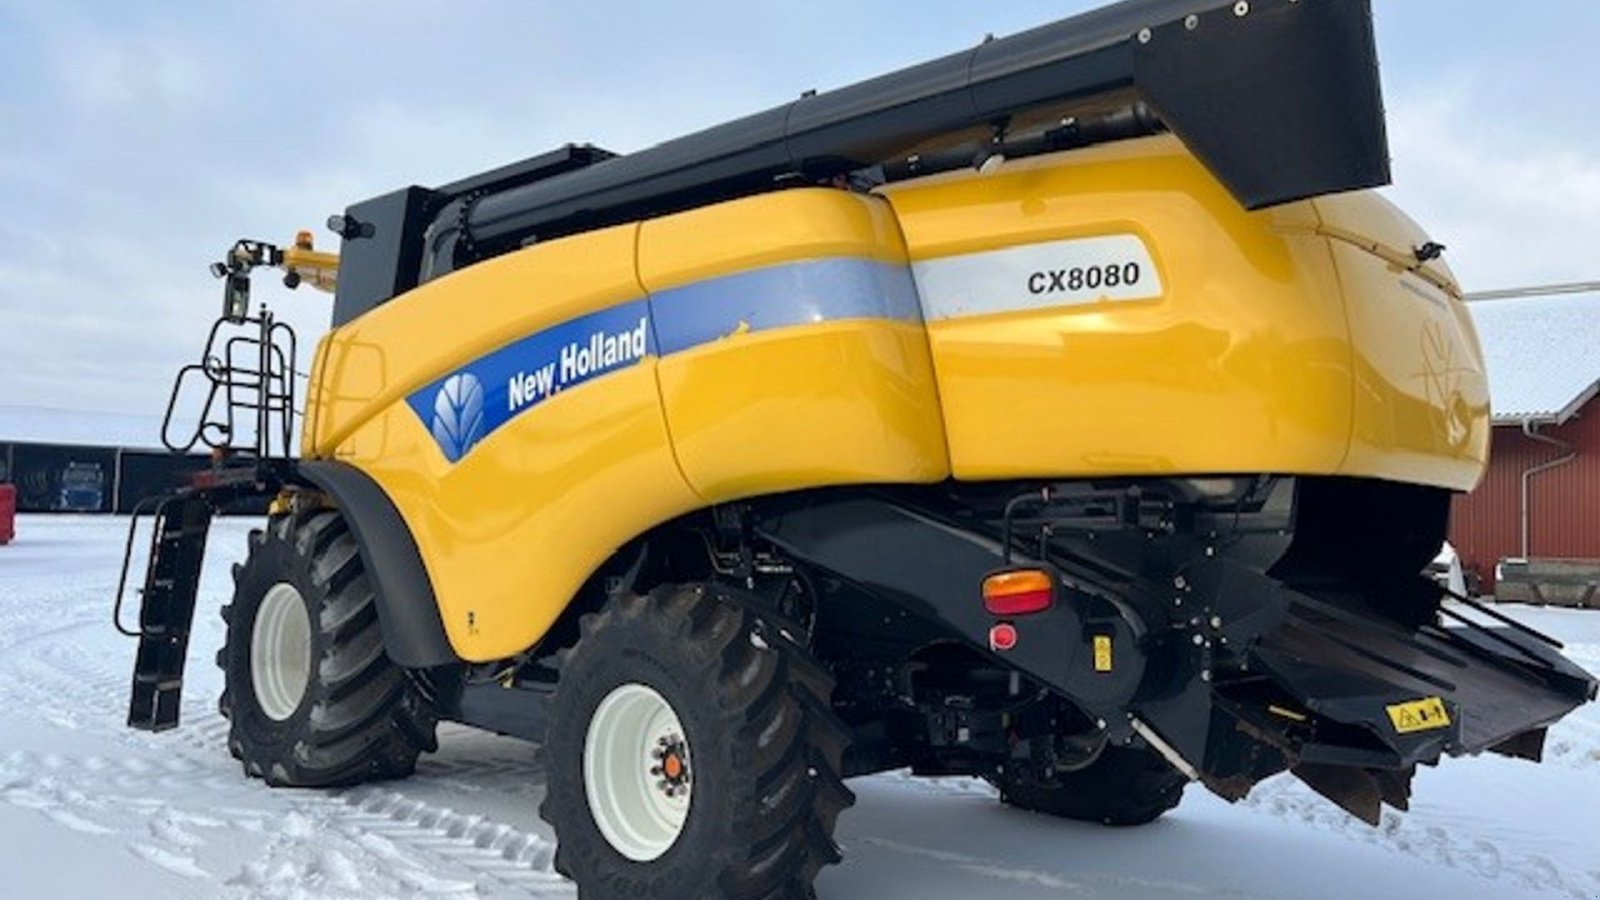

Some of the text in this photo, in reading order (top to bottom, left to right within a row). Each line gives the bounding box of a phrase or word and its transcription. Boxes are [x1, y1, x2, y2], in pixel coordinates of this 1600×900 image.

[1028, 262, 1140, 294] CX8080
[508, 317, 647, 411] New Holland
